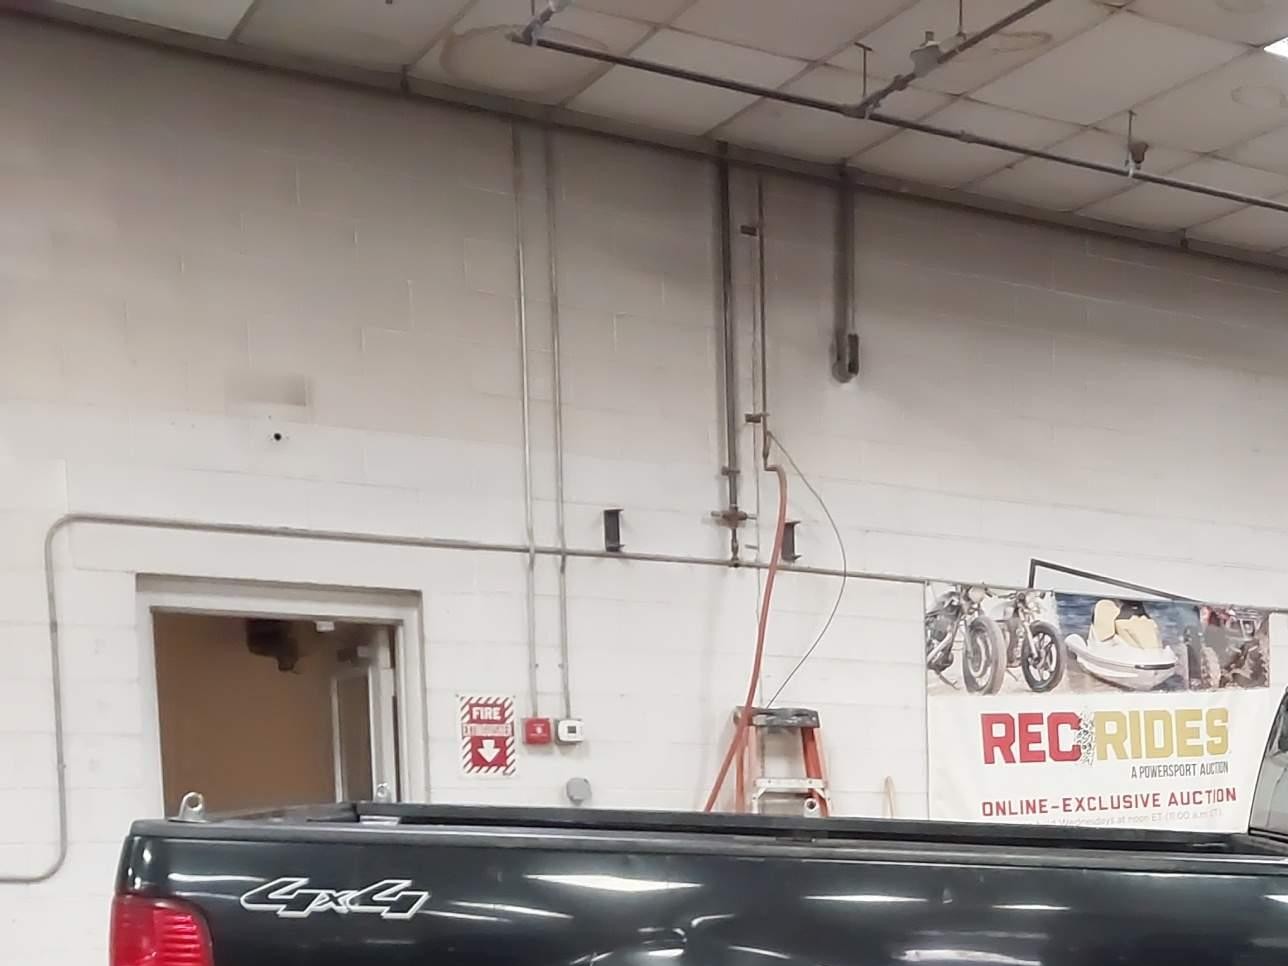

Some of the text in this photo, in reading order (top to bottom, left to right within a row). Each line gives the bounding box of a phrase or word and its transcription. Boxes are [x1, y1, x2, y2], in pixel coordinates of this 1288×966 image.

[471, 706, 501, 720] FIRE
[980, 708, 1230, 764] REC RIDES
[1131, 761, 1229, 779] A POWERSPORT AUCTION
[982, 787, 1237, 817] ONLINE-EXCLUSIVE AUCTION
[240, 877, 431, 920] 4x4
